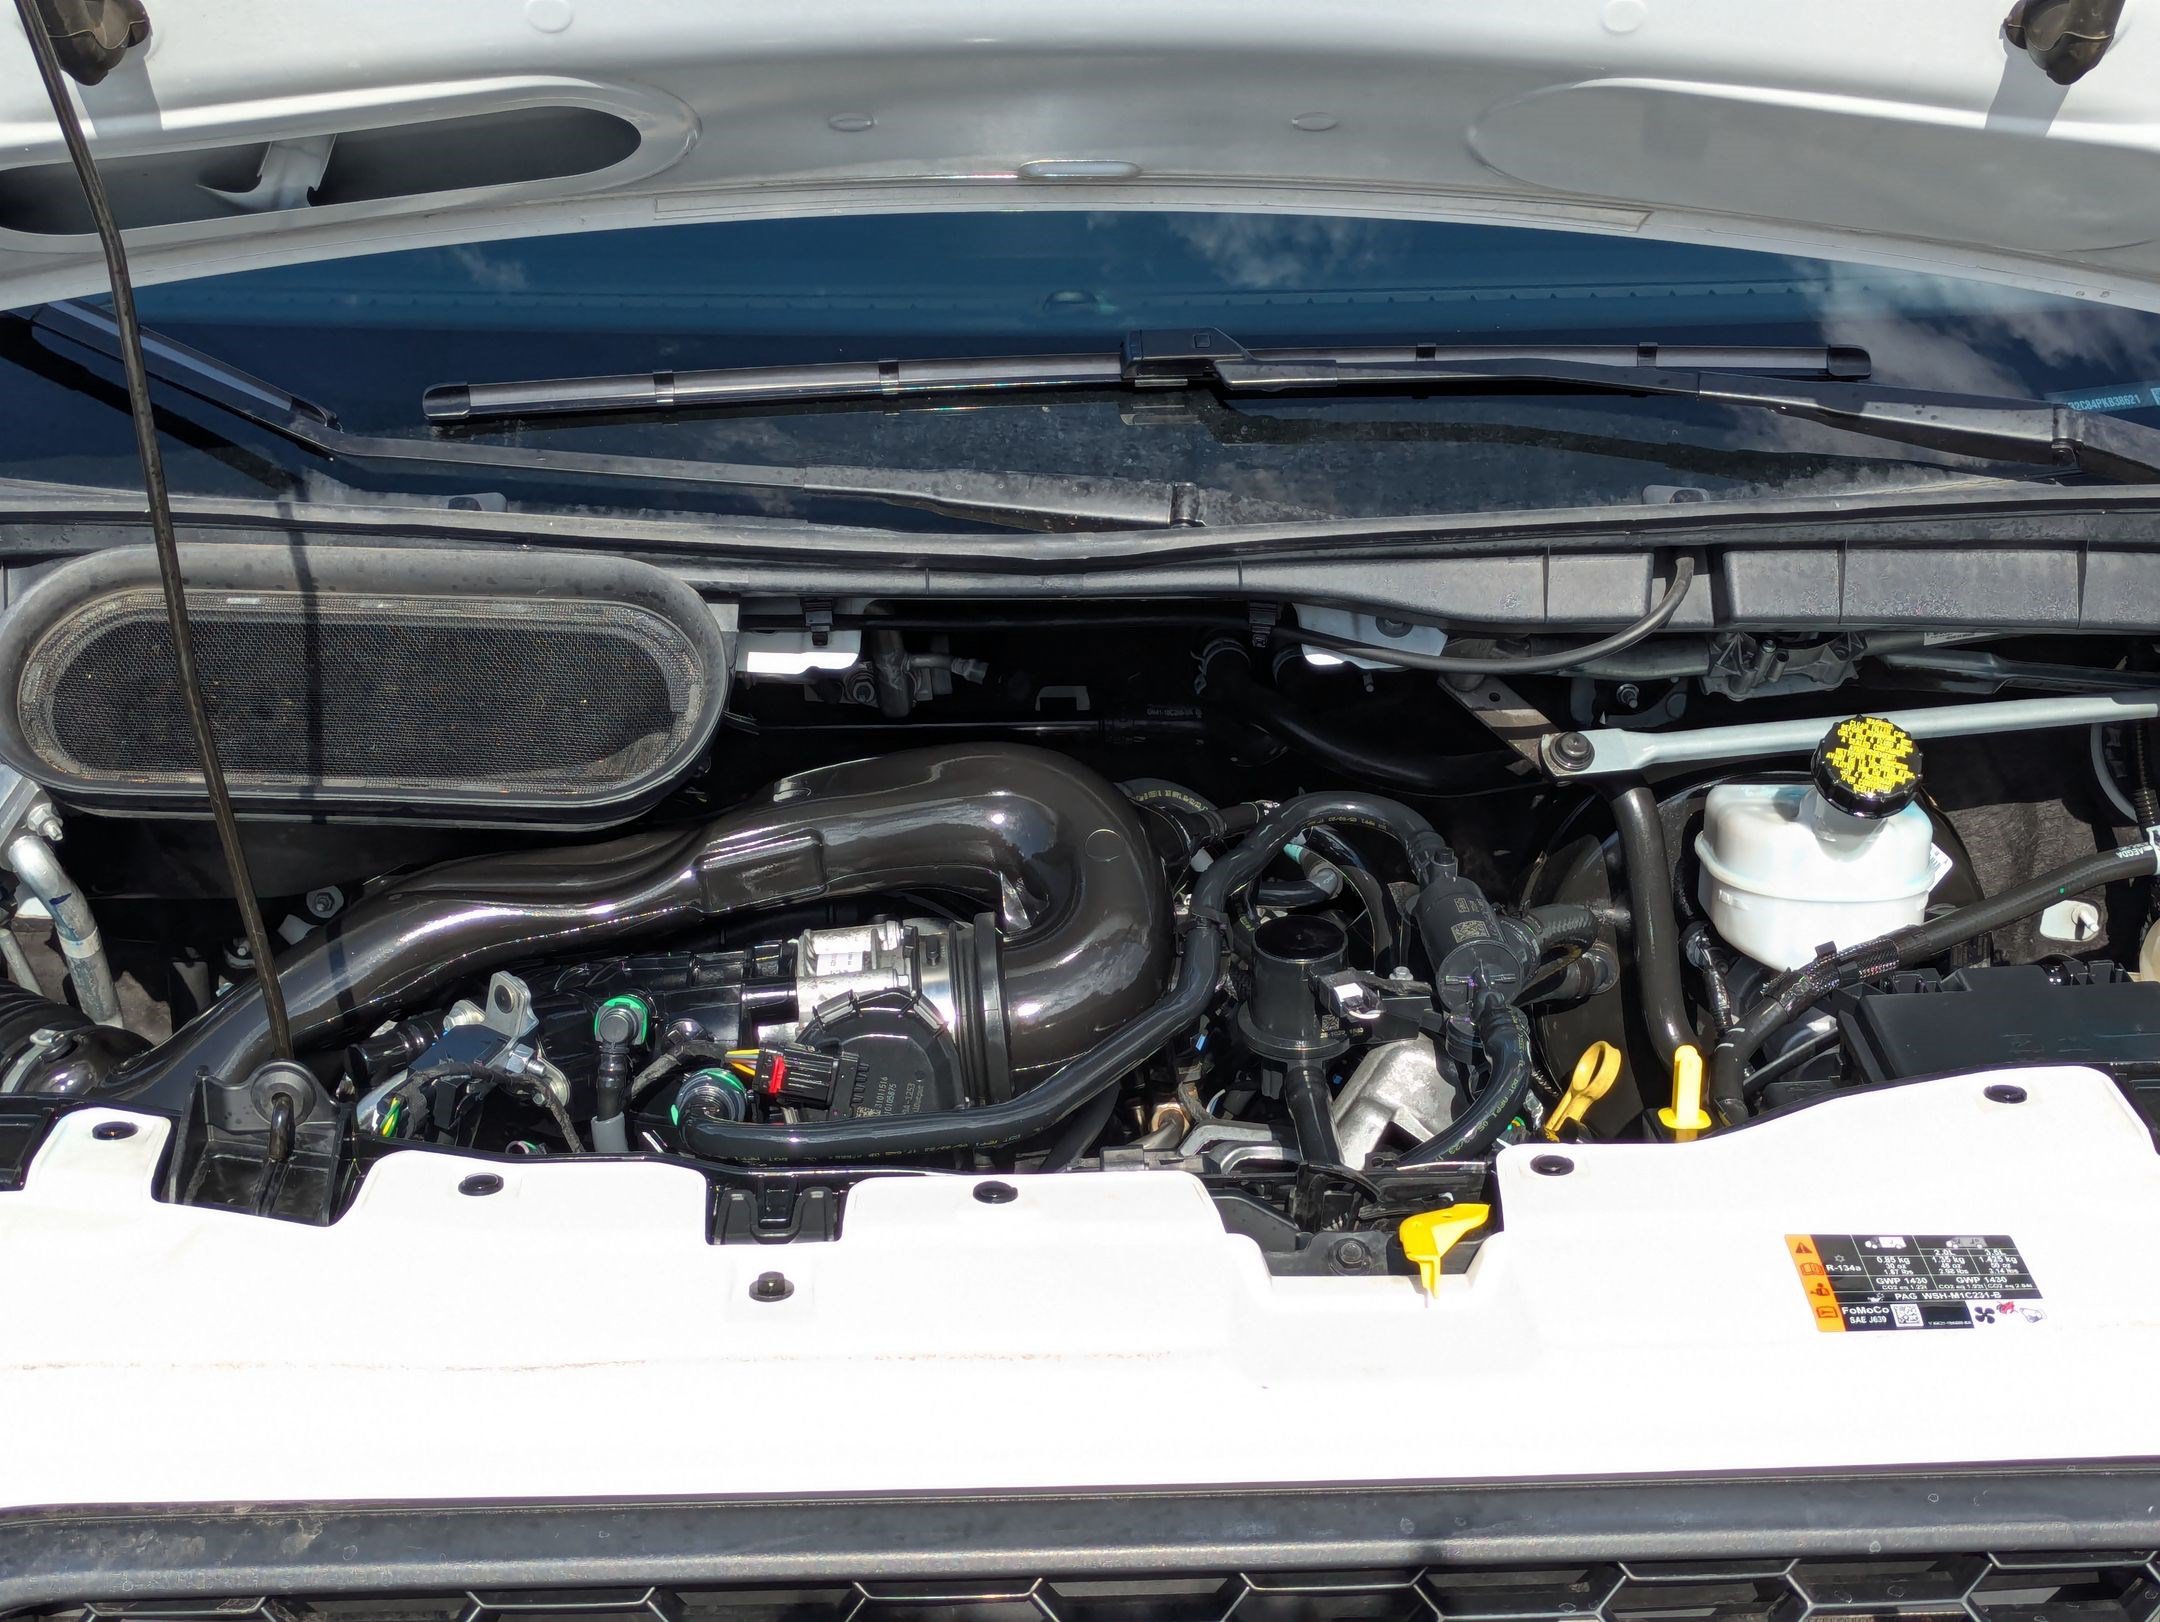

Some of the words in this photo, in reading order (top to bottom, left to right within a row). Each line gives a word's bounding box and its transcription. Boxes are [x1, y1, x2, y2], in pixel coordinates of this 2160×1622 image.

[1898, 1256, 1910, 1264] kg
[1952, 1256, 1965, 1264] kg
[2005, 1256, 2018, 1264] kg
[1826, 1264, 1861, 1272] R-134a
[1841, 1306, 1889, 1315] FoMoCo
[1850, 1316, 1867, 1324] SAE
